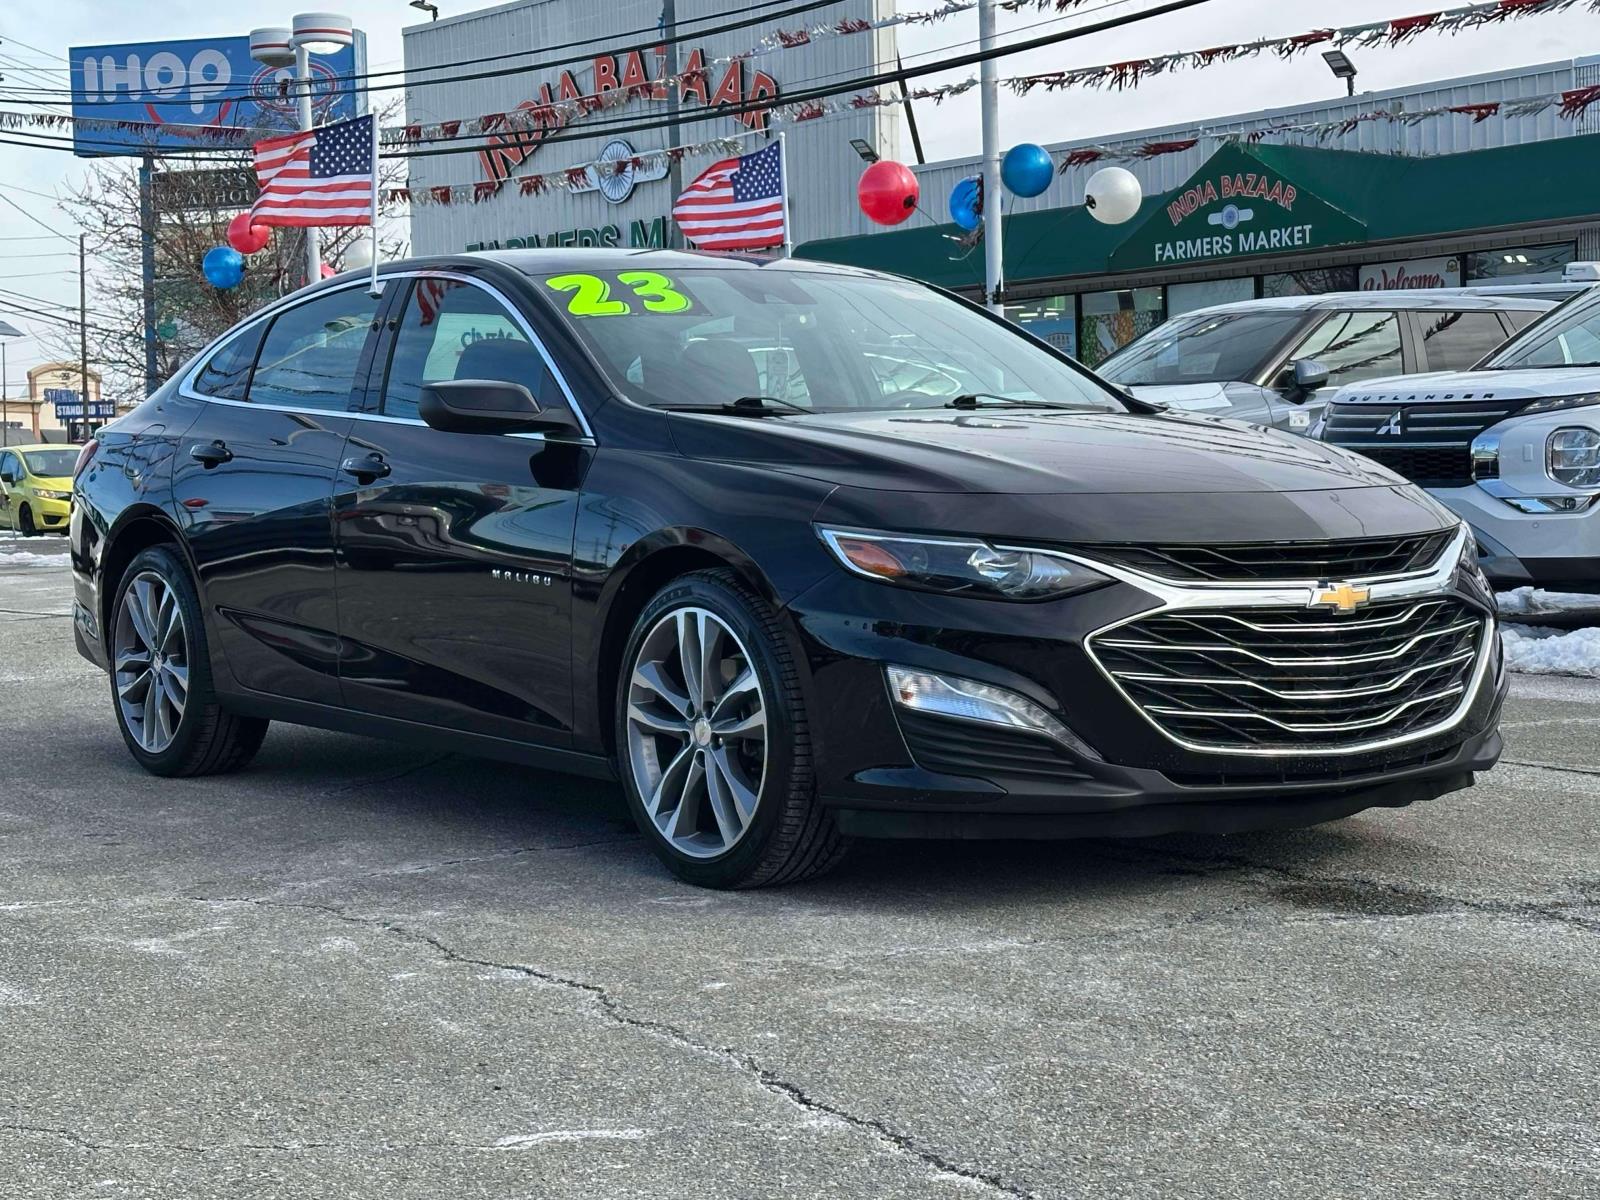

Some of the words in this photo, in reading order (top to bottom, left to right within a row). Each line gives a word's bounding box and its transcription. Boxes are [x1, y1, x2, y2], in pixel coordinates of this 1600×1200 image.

[84, 49, 231, 114] IHOP
[478, 69, 588, 182] INDIA
[592, 44, 778, 138] BAZAAR
[1167, 180, 1218, 227] INDIA
[1221, 173, 1297, 211] BAZAAR
[1155, 235, 1233, 261] FARMERS
[1238, 224, 1312, 251] MARKET
[545, 271, 693, 318] 23
[1363, 267, 1441, 290] Welcome
[99, 404, 114, 415] TILE
[1349, 393, 1495, 402] OUTLANDER
[491, 569, 552, 586] MALIBU
